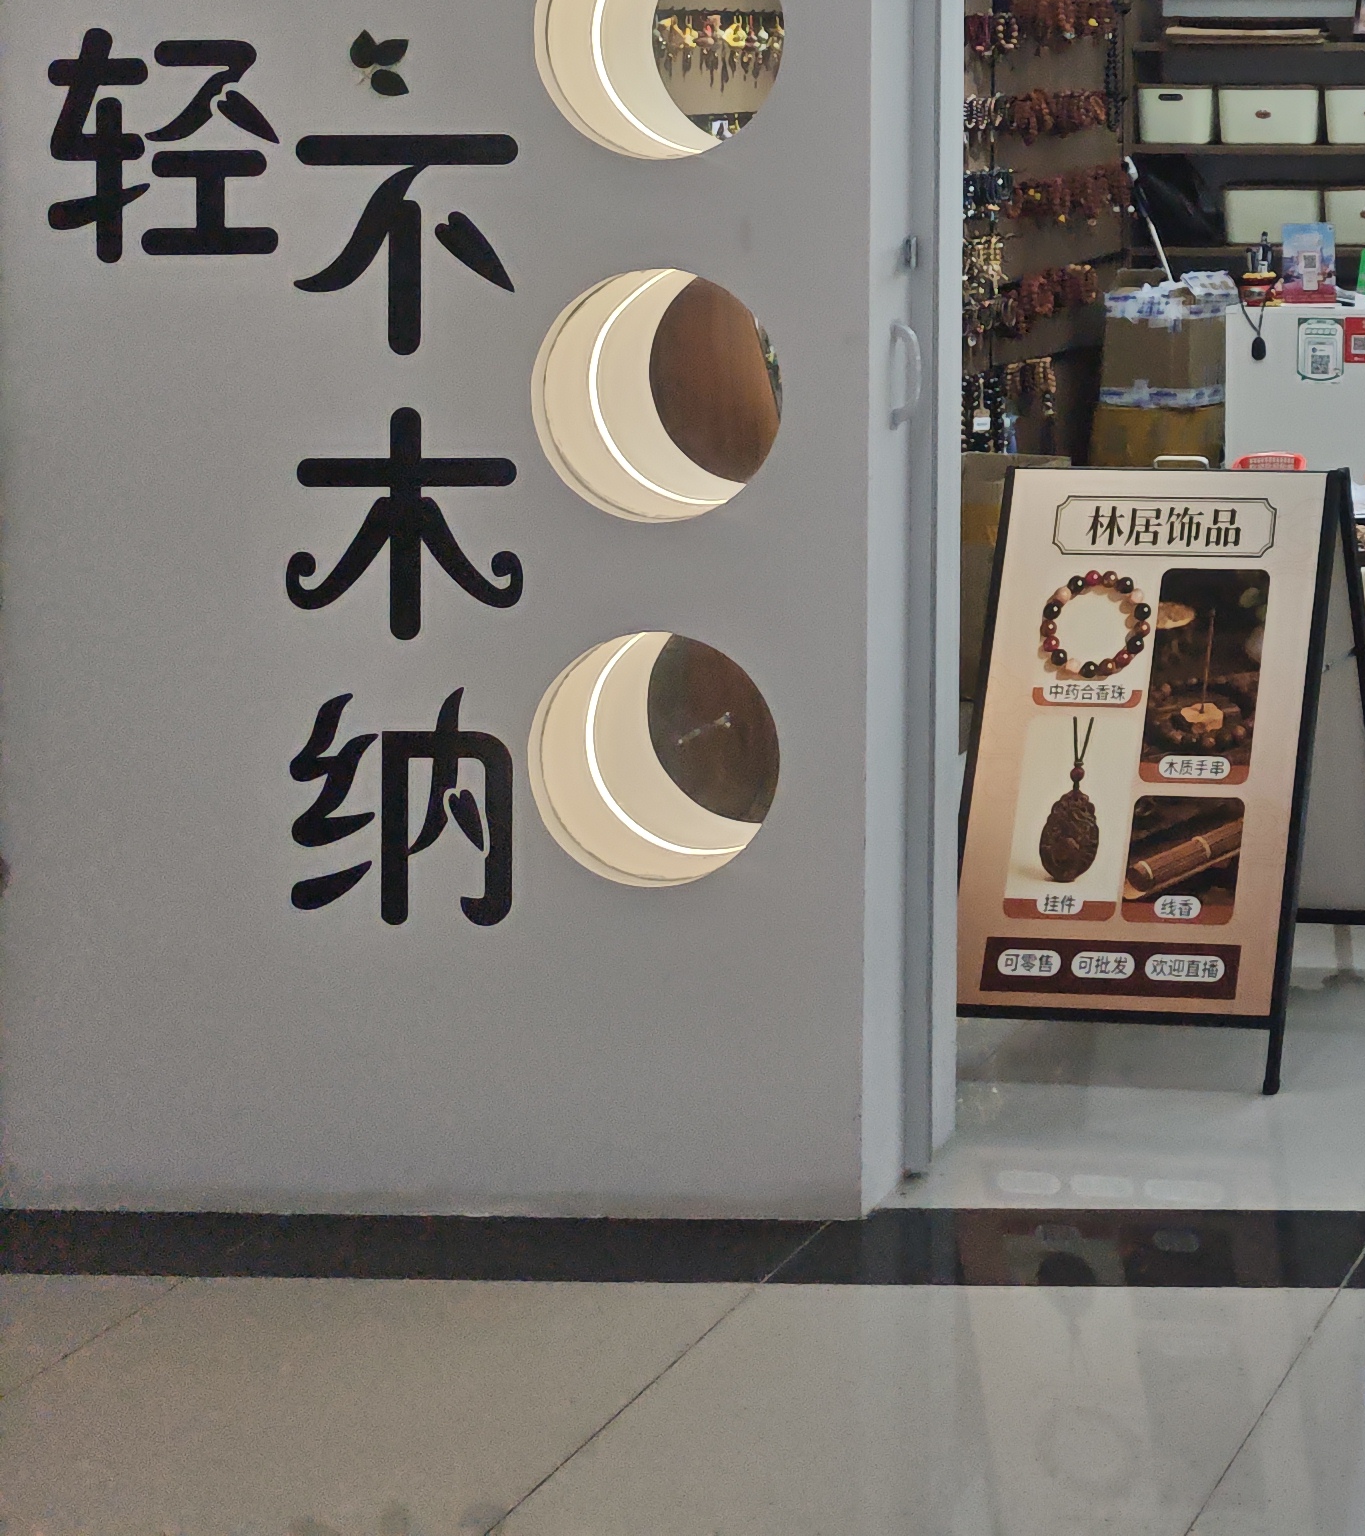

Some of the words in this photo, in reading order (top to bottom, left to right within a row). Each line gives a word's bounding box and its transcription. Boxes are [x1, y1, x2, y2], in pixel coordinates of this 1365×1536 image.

[285, 133, 524, 927] 不木纳
[1086, 505, 1242, 549] 林居饰品
[1049, 683, 1126, 702] 中药合香珠
[1163, 758, 1226, 777] 木质手串
[1043, 893, 1076, 914] 挂件
[1160, 898, 1194, 917] 线香
[1003, 953, 1054, 973] 可零售
[1077, 955, 1129, 976] 可批发
[1150, 958, 1220, 979] 欢迎直播
